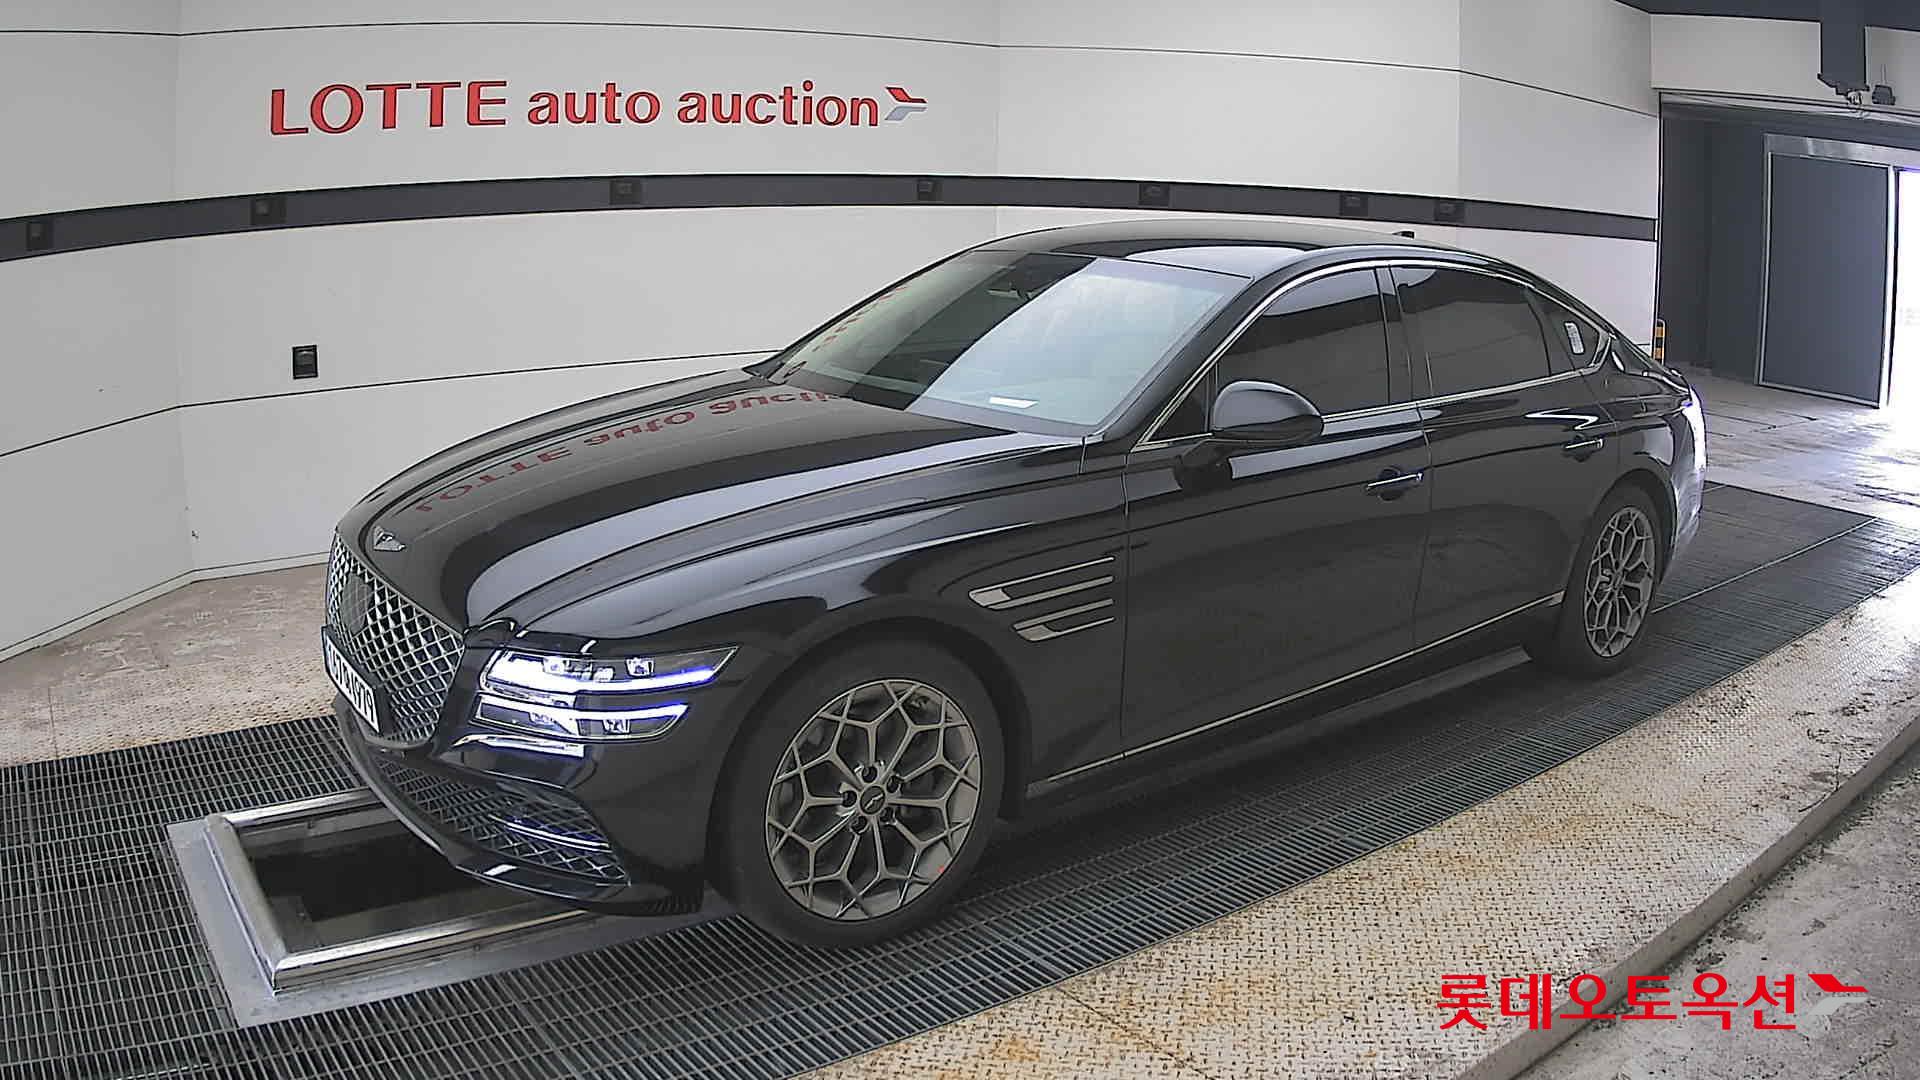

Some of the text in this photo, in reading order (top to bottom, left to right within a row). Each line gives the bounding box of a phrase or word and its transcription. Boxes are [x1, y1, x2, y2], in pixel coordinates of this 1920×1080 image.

[270, 80, 879, 136] LOTTE auto auction
